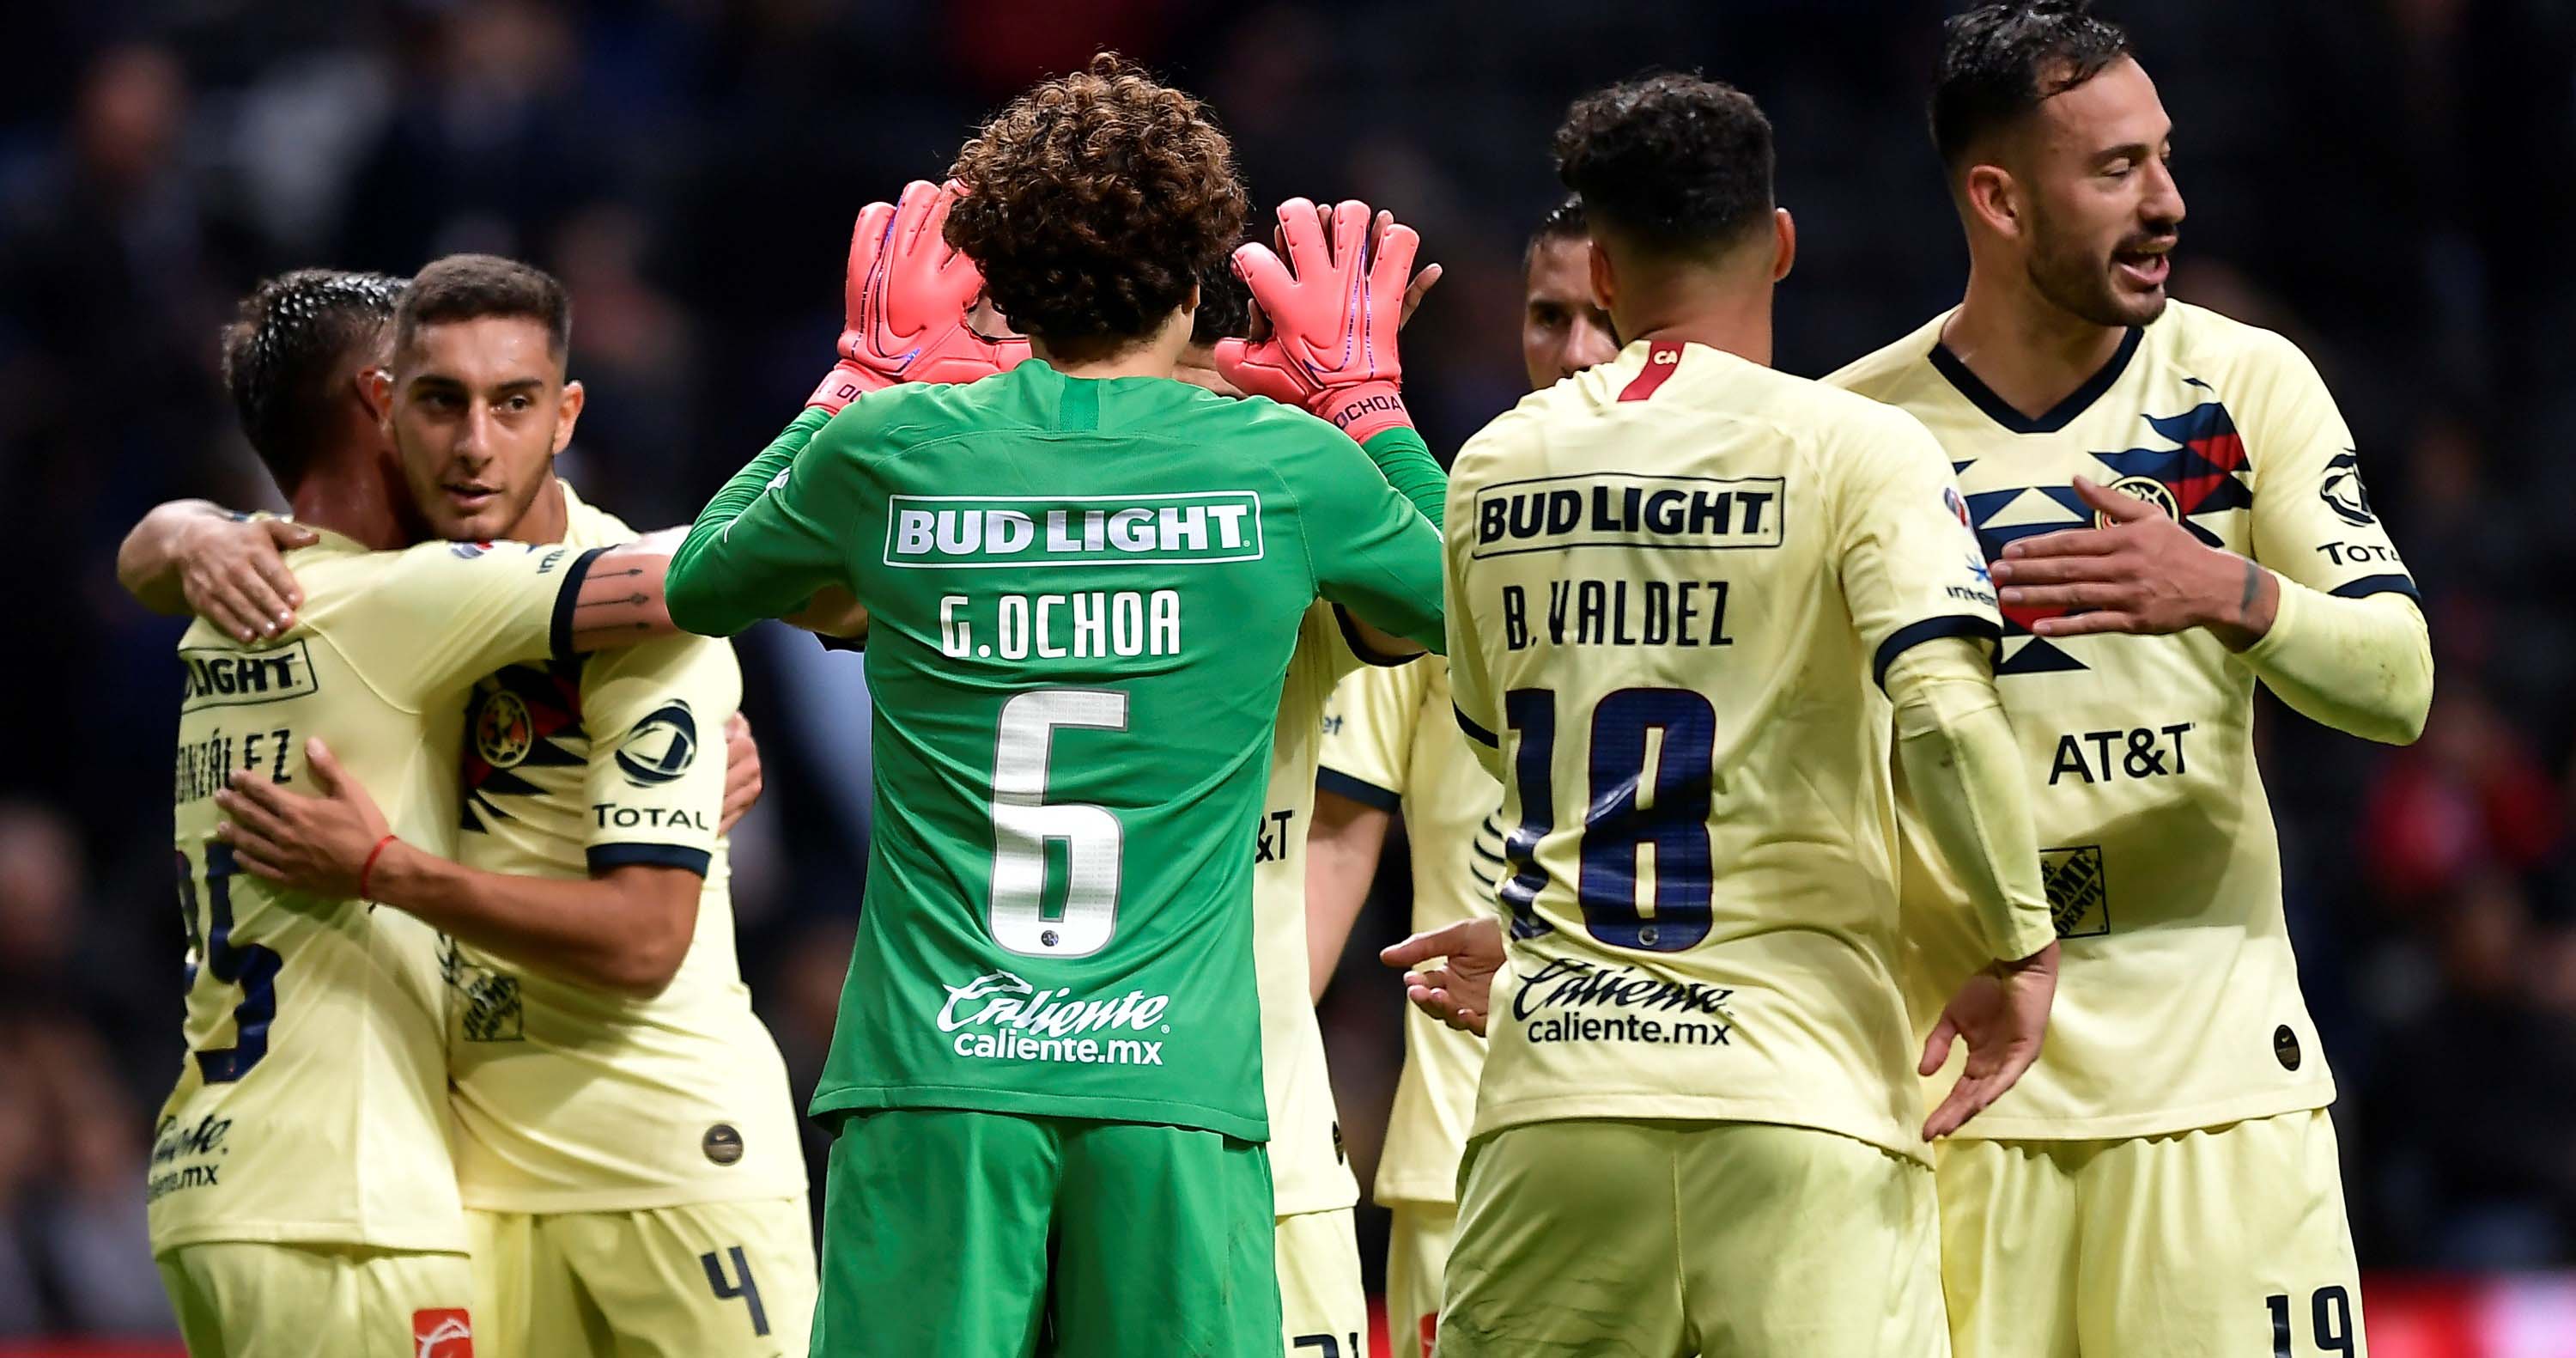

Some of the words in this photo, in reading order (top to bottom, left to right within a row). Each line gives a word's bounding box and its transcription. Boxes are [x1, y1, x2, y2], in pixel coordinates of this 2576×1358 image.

[1653, 350, 1679, 365] CA
[1334, 395, 1404, 429] OCHOA
[896, 509, 1032, 555] BUD
[1046, 505, 1249, 552] LIGHT
[1479, 486, 1583, 543] BUD
[1591, 486, 1773, 535] LIGHT
[940, 590, 1182, 659] G.OCHOA
[191, 653, 295, 697] LIGHT
[176, 728, 292, 803] ONZÁLEZ
[2049, 723, 2191, 785] AT&T
[592, 802, 708, 831] TOTAL
[989, 690, 1129, 956] 6
[1499, 687, 1716, 953] 18
[937, 969, 1170, 1038] Caliente
[1513, 958, 1734, 1022] Caliente
[953, 1027, 1163, 1065] caliente.mx
[1528, 1011, 1731, 1045] caliente.mx
[701, 1246, 769, 1336] 4
[2266, 1285, 2354, 1358] 19
